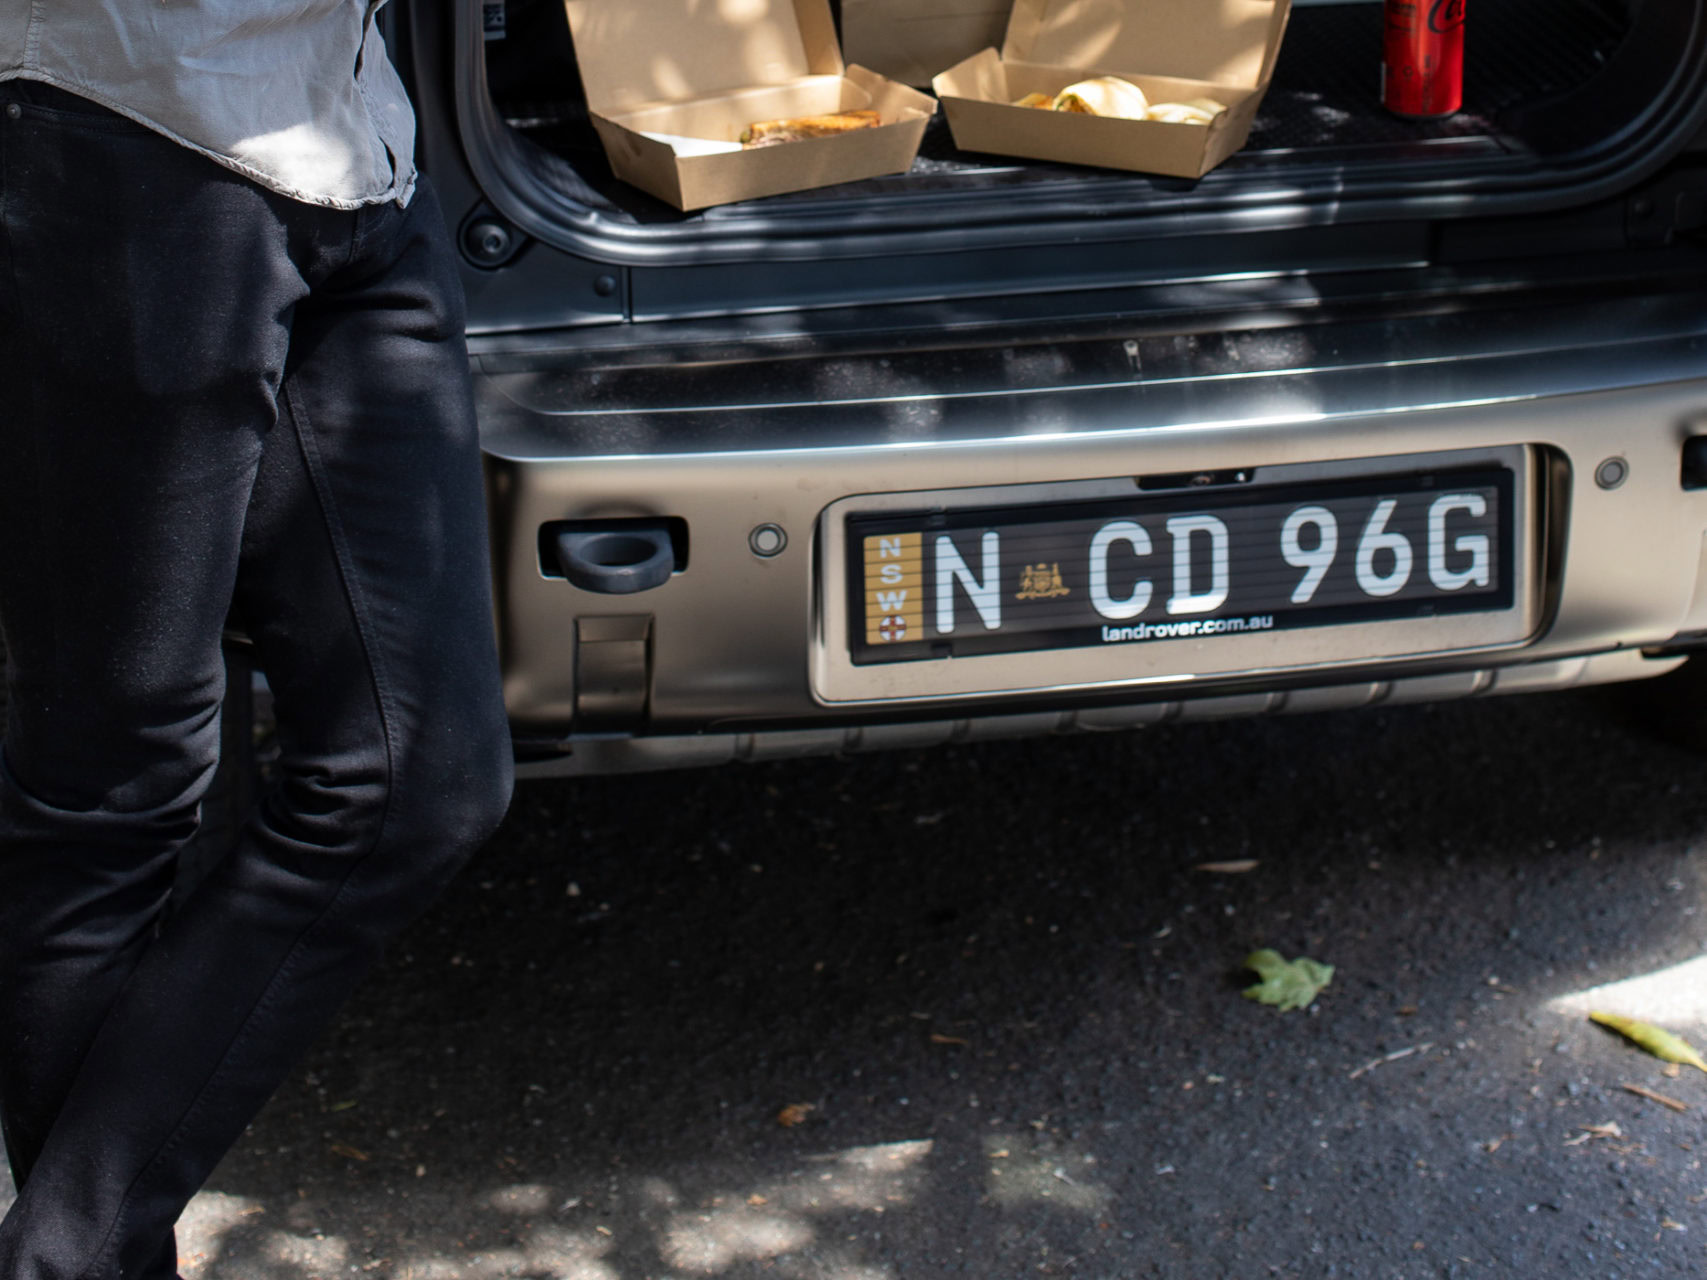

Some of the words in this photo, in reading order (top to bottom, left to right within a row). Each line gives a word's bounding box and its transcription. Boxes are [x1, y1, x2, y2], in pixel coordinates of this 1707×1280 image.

[936, 531, 1001, 634] N
[1088, 514, 1229, 620] CD
[1279, 494, 1490, 604] 96G
[1102, 615, 1273, 642] landrover.com.au
